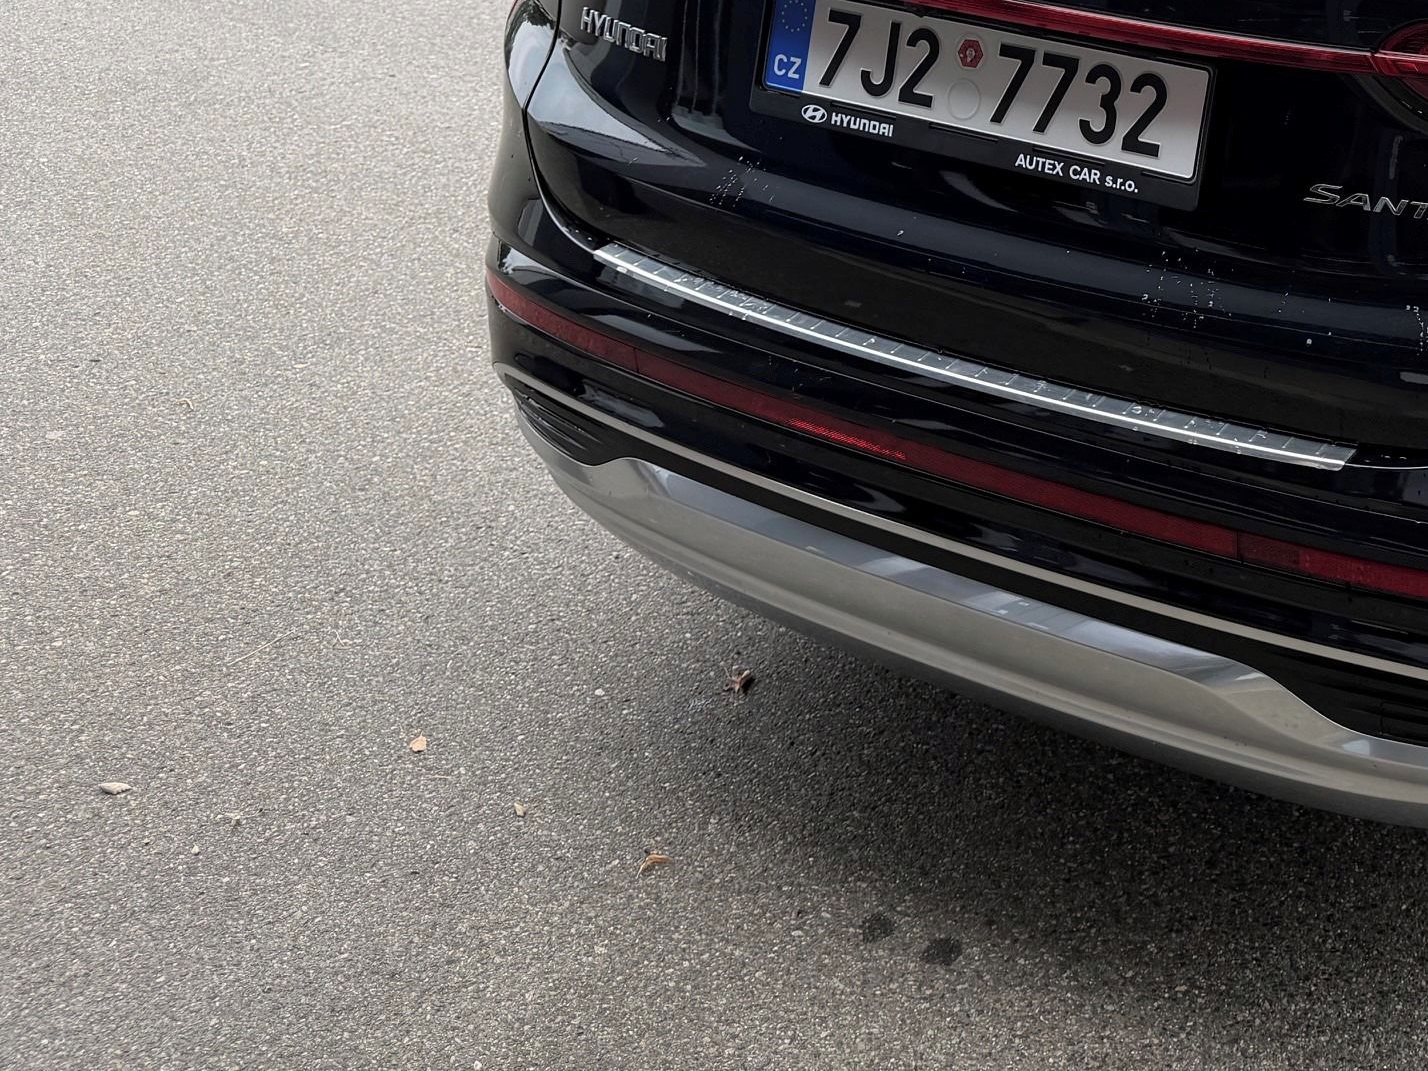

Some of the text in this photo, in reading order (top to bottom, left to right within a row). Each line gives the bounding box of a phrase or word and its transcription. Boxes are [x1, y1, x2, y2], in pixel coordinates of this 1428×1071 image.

[581, 6, 668, 62] HYUNDAI
[773, 53, 801, 80] CZ
[819, 9, 1168, 158] 7J2 7732
[831, 112, 894, 137] HYUNDAI
[1015, 153, 1138, 193] AUTEX CAR s.r.o.
